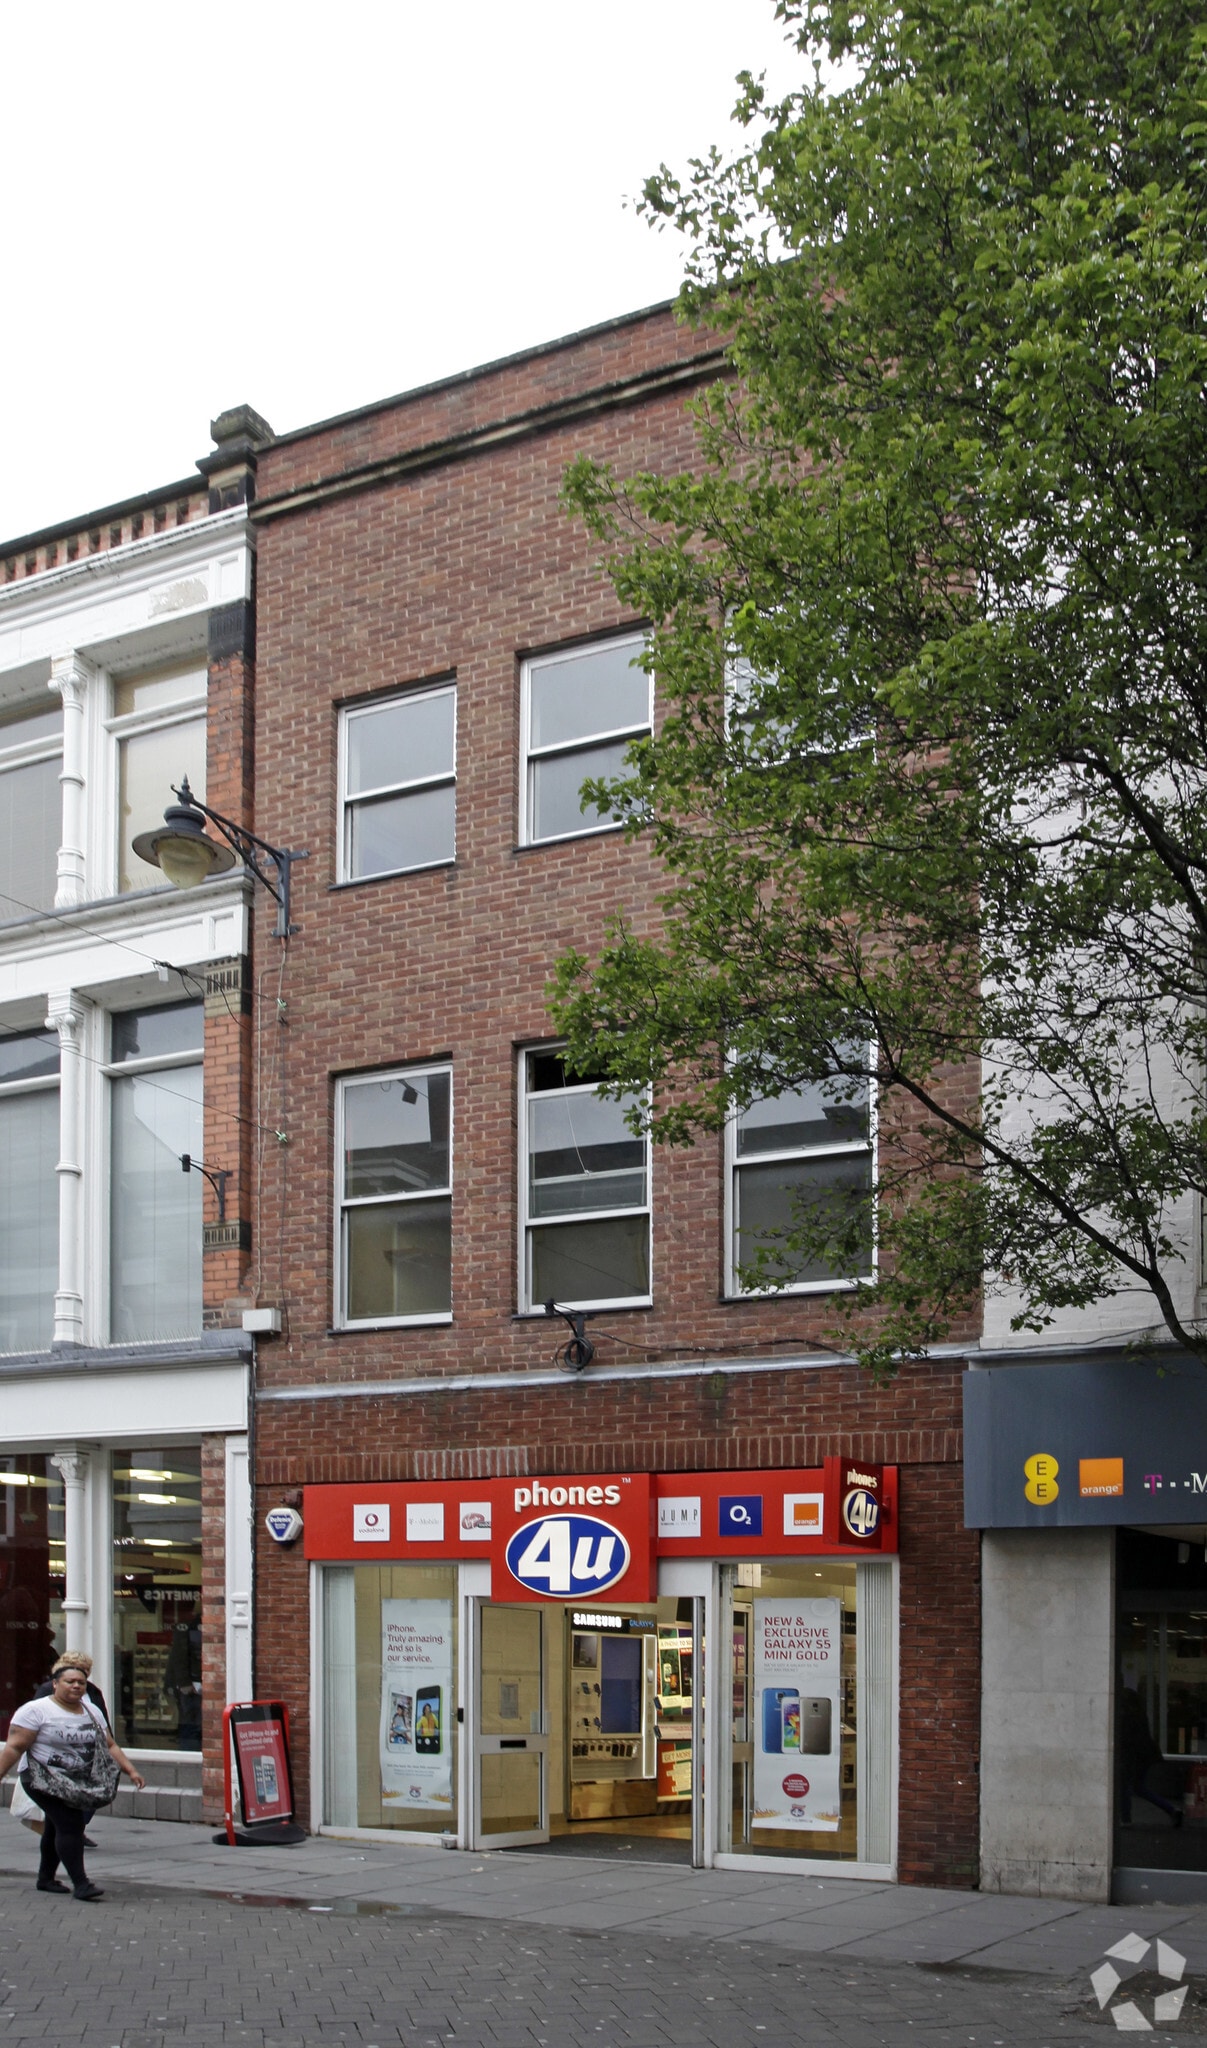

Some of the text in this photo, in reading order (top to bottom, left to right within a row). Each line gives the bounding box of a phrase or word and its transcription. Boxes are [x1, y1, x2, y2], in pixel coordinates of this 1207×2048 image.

[847, 1468, 878, 1488] phones
[1081, 1484, 1119, 1495] orange
[514, 1480, 621, 1513] phones
[660, 1508, 698, 1521] JUMP
[729, 1505, 752, 1525] O2
[850, 1492, 878, 1534] 4u
[794, 1518, 818, 1526] orange
[518, 1520, 616, 1591] 4u
[573, 1612, 622, 1628] SAMSUNG
[764, 1616, 805, 1626] NEW &
[387, 1624, 417, 1632] iPhone.
[764, 1628, 829, 1638] EXCLUSIVE
[388, 1634, 445, 1645] Truly amazing.
[764, 1639, 831, 1649] GALAXY S5
[387, 1644, 403, 1652] And
[416, 1644, 422, 1652] is
[402, 1654, 432, 1663] service.
[764, 1650, 829, 1660] MINI GOLD
